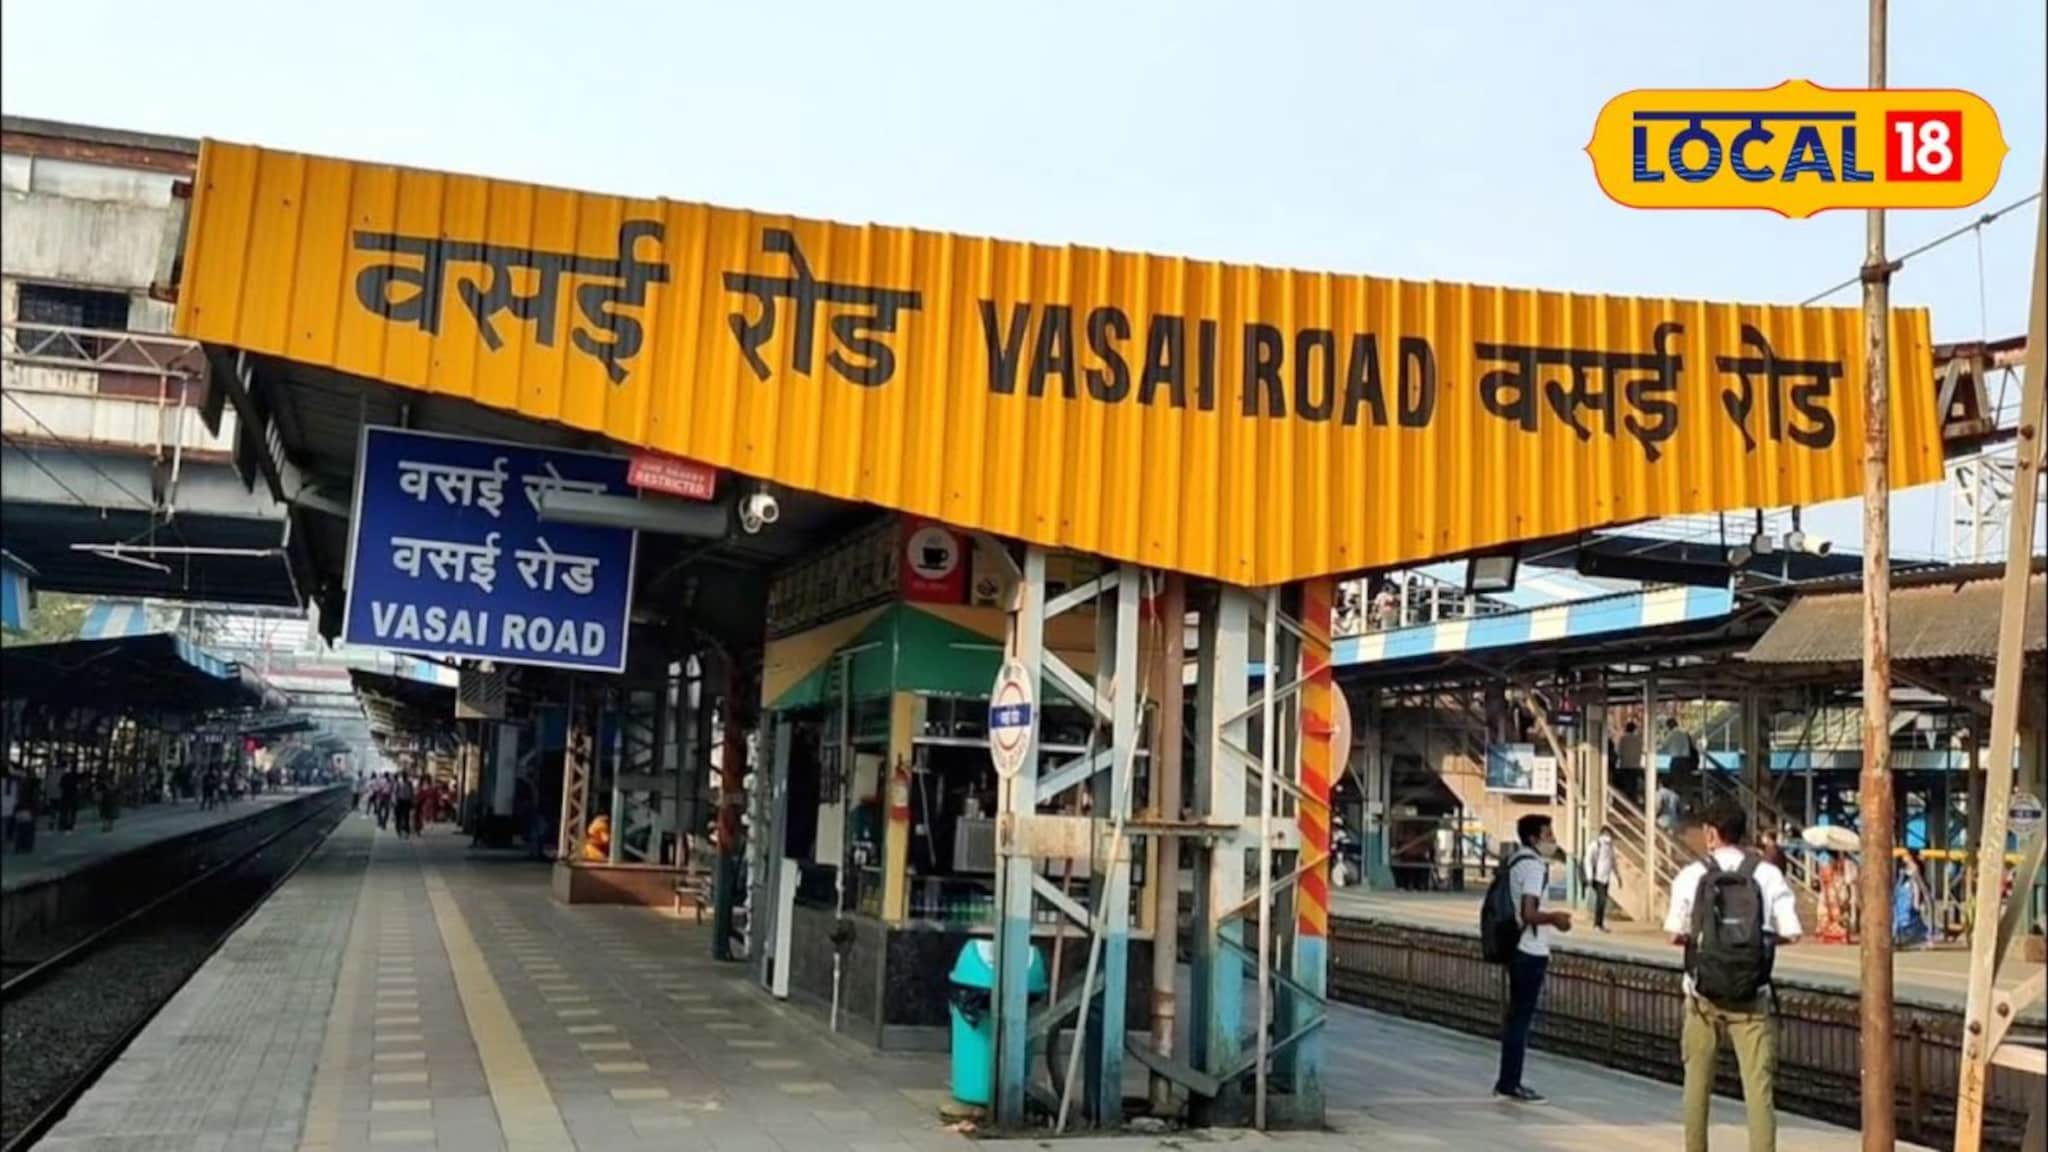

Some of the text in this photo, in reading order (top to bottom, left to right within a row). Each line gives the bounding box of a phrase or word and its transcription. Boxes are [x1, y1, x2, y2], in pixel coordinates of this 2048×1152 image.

[353, 220, 1843, 463] वसई रोड VASAI ROAD वसई रोड
[398, 457, 508, 517] वसई
[391, 532, 599, 594] वसई रोड
[371, 602, 606, 657] VASAI ROAD
